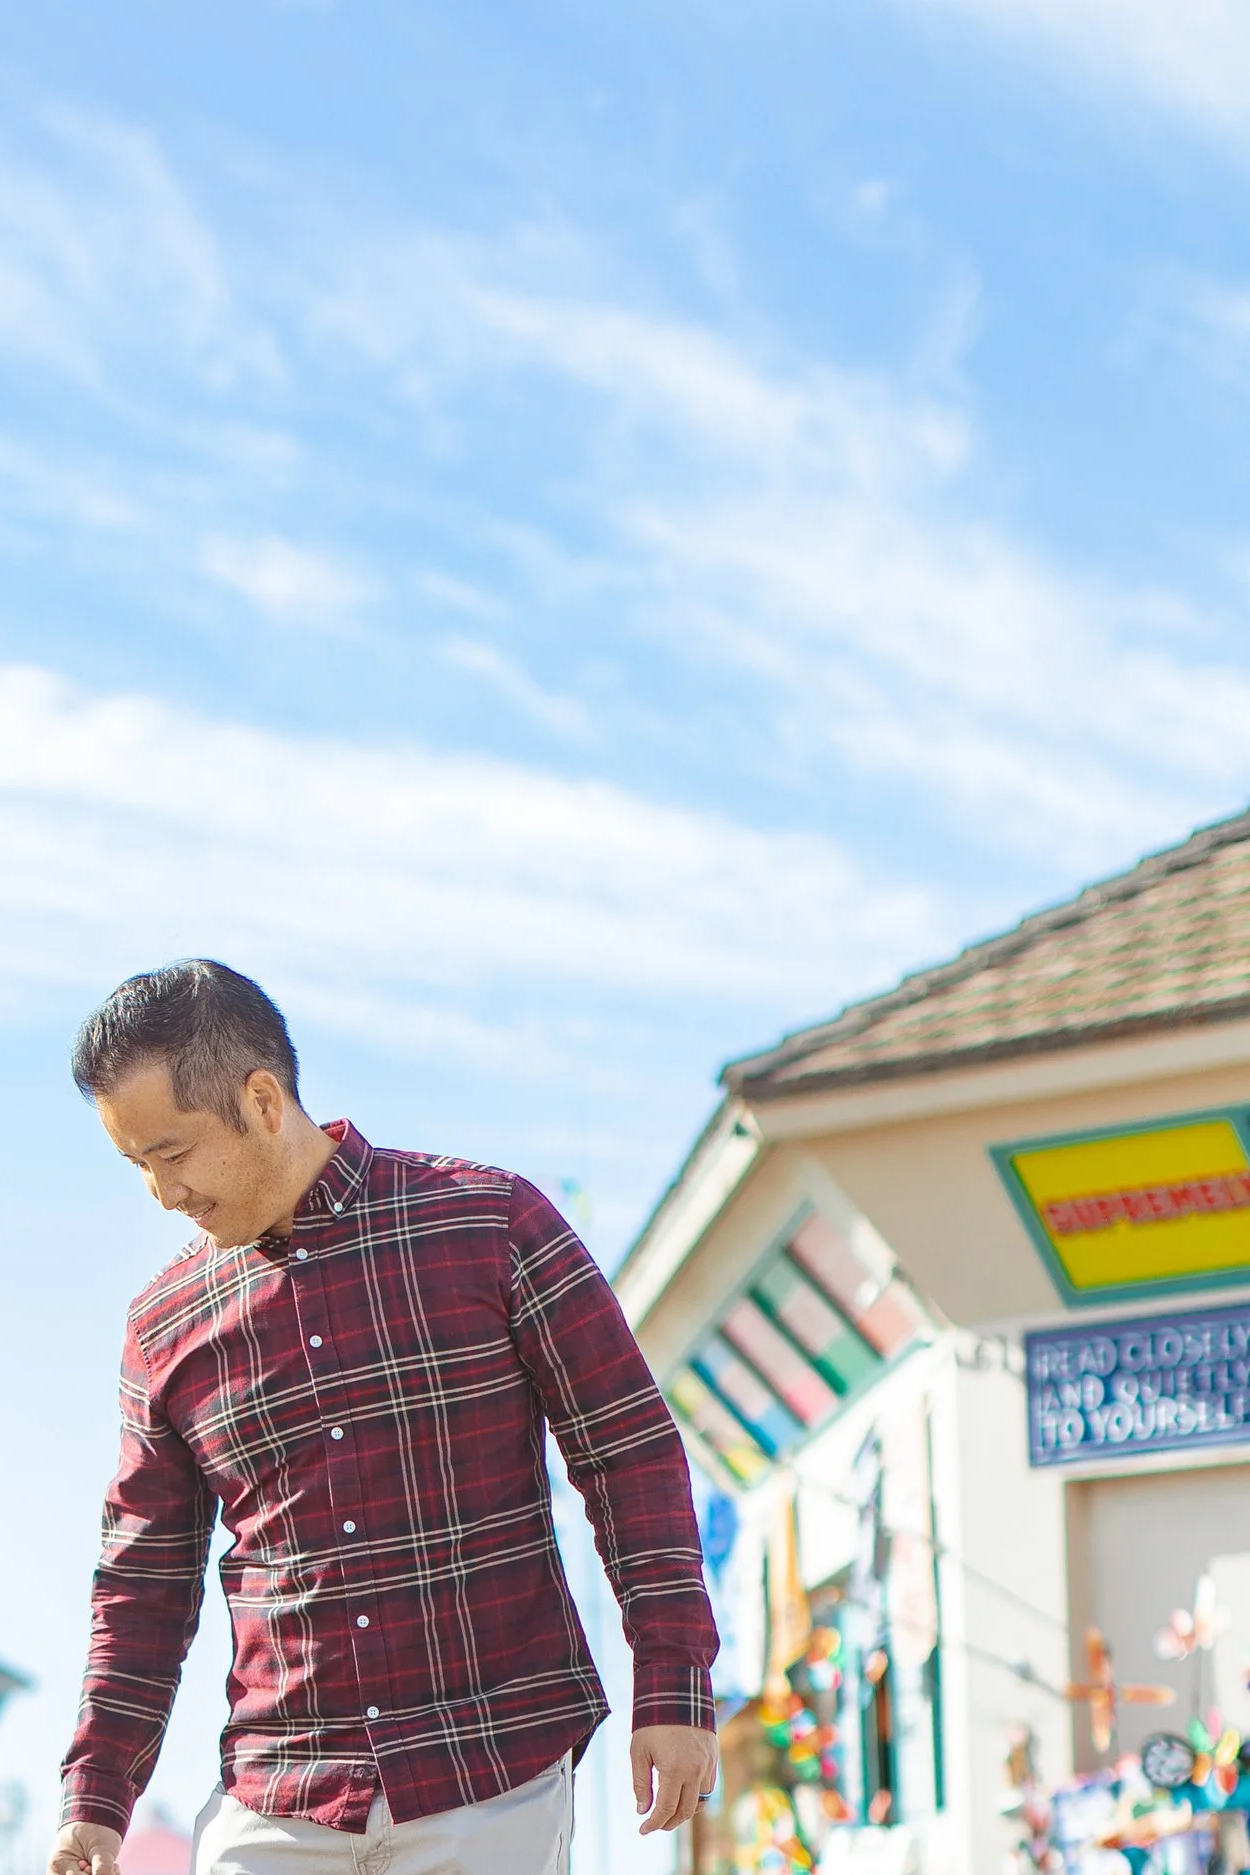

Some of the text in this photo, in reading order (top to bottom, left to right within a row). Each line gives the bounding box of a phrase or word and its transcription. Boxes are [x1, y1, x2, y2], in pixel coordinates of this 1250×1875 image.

[1034, 1336, 1117, 1381] READ
[1041, 1374, 1105, 1412] AND
[1042, 1407, 1085, 1449] TO
